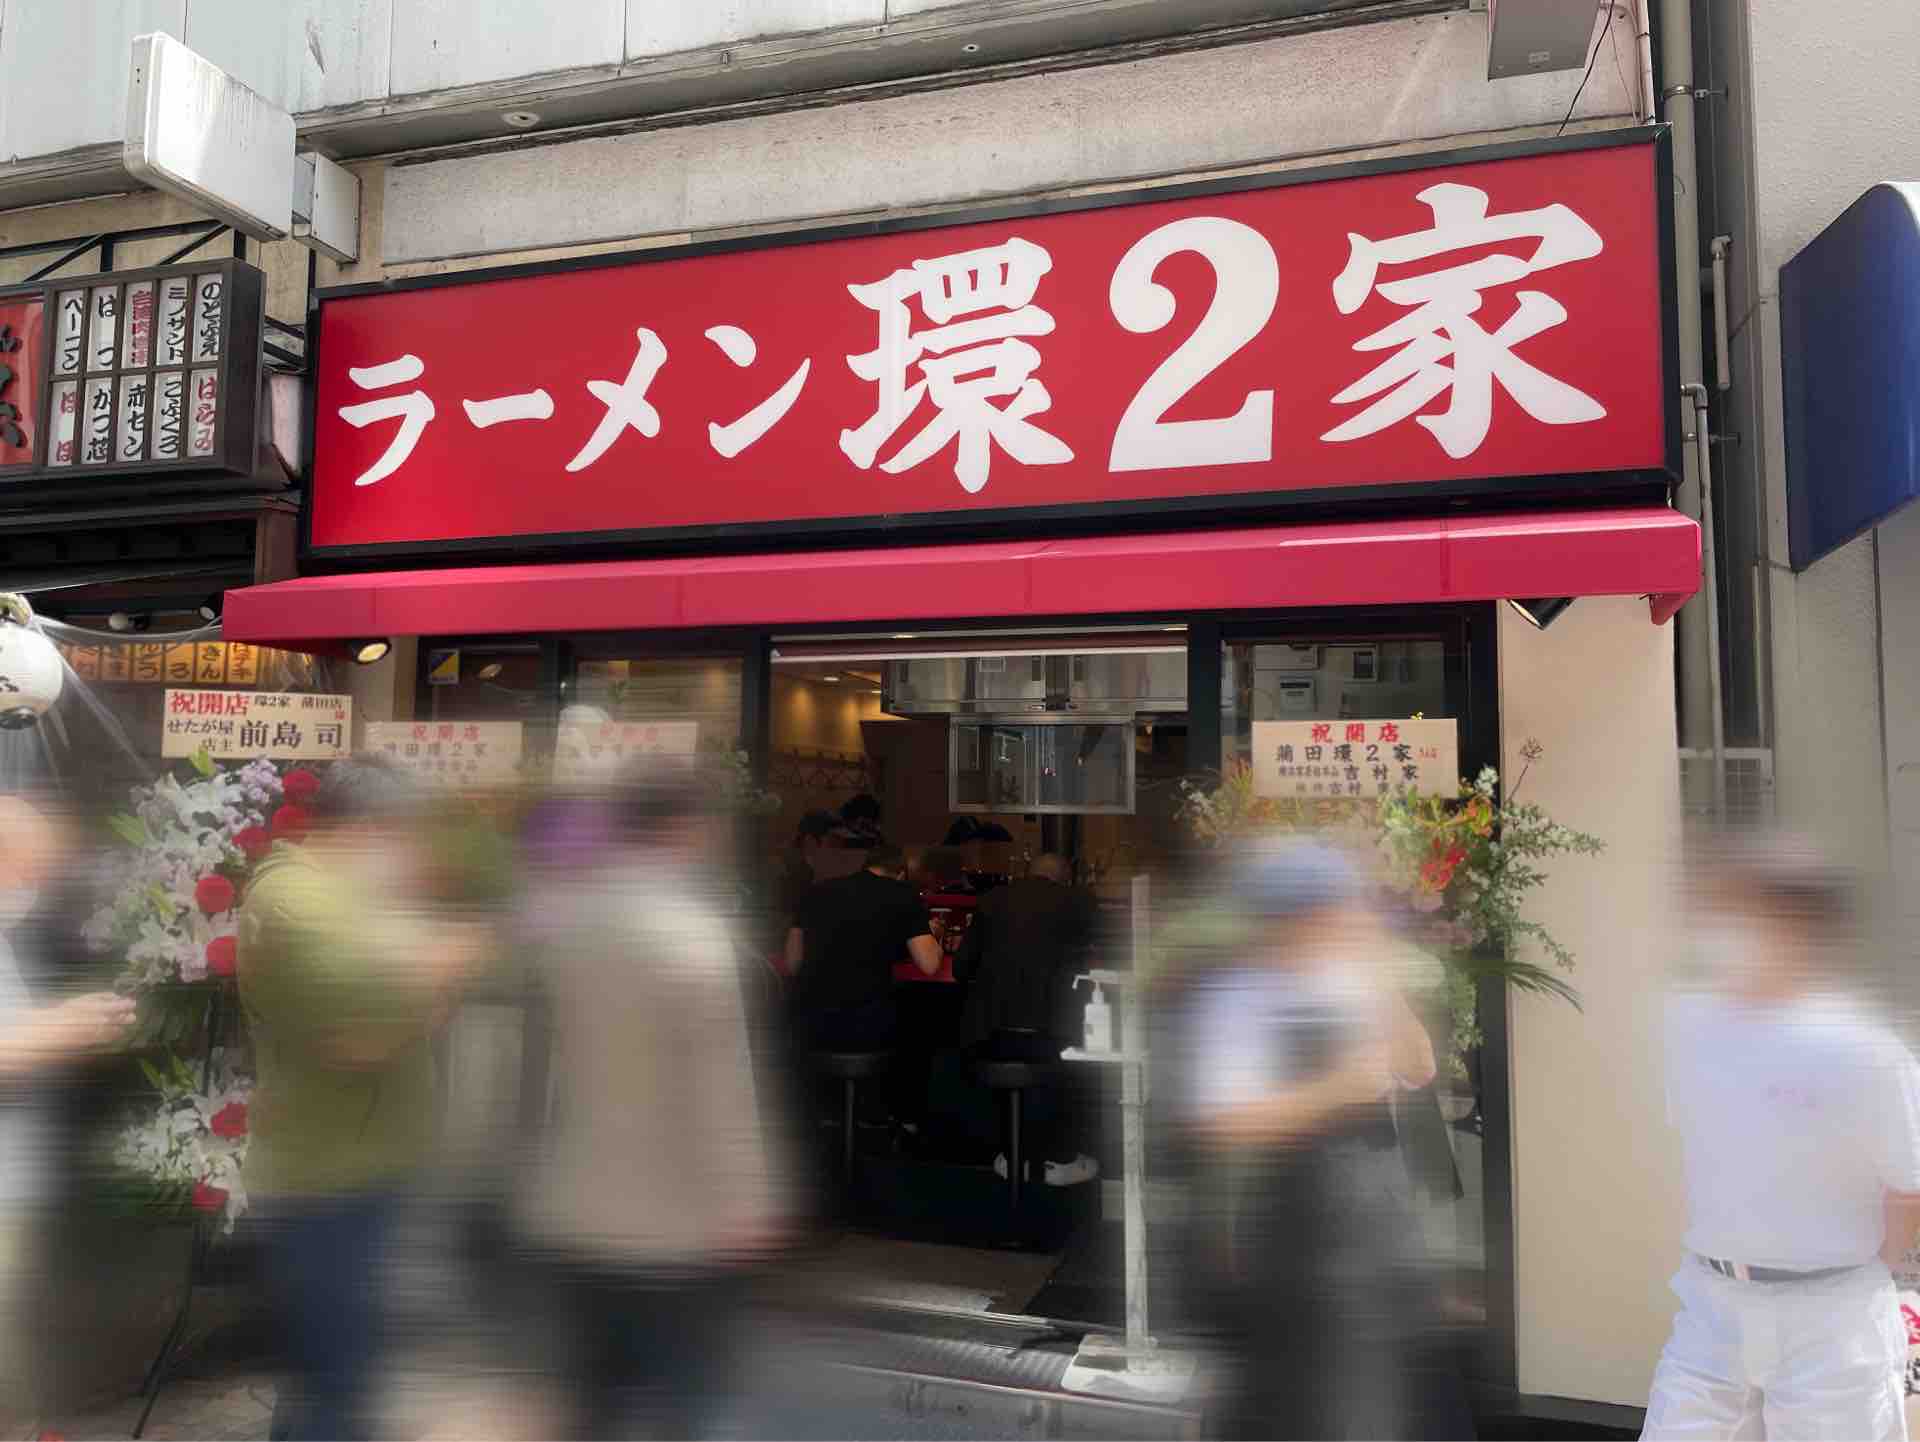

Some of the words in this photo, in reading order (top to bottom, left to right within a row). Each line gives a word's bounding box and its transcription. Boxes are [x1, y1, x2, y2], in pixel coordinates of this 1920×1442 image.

[168, 692, 250, 715] 祝開店
[240, 720, 303, 748] 前島
[314, 723, 343, 748] 司
[1311, 722, 1400, 743] 祝開店
